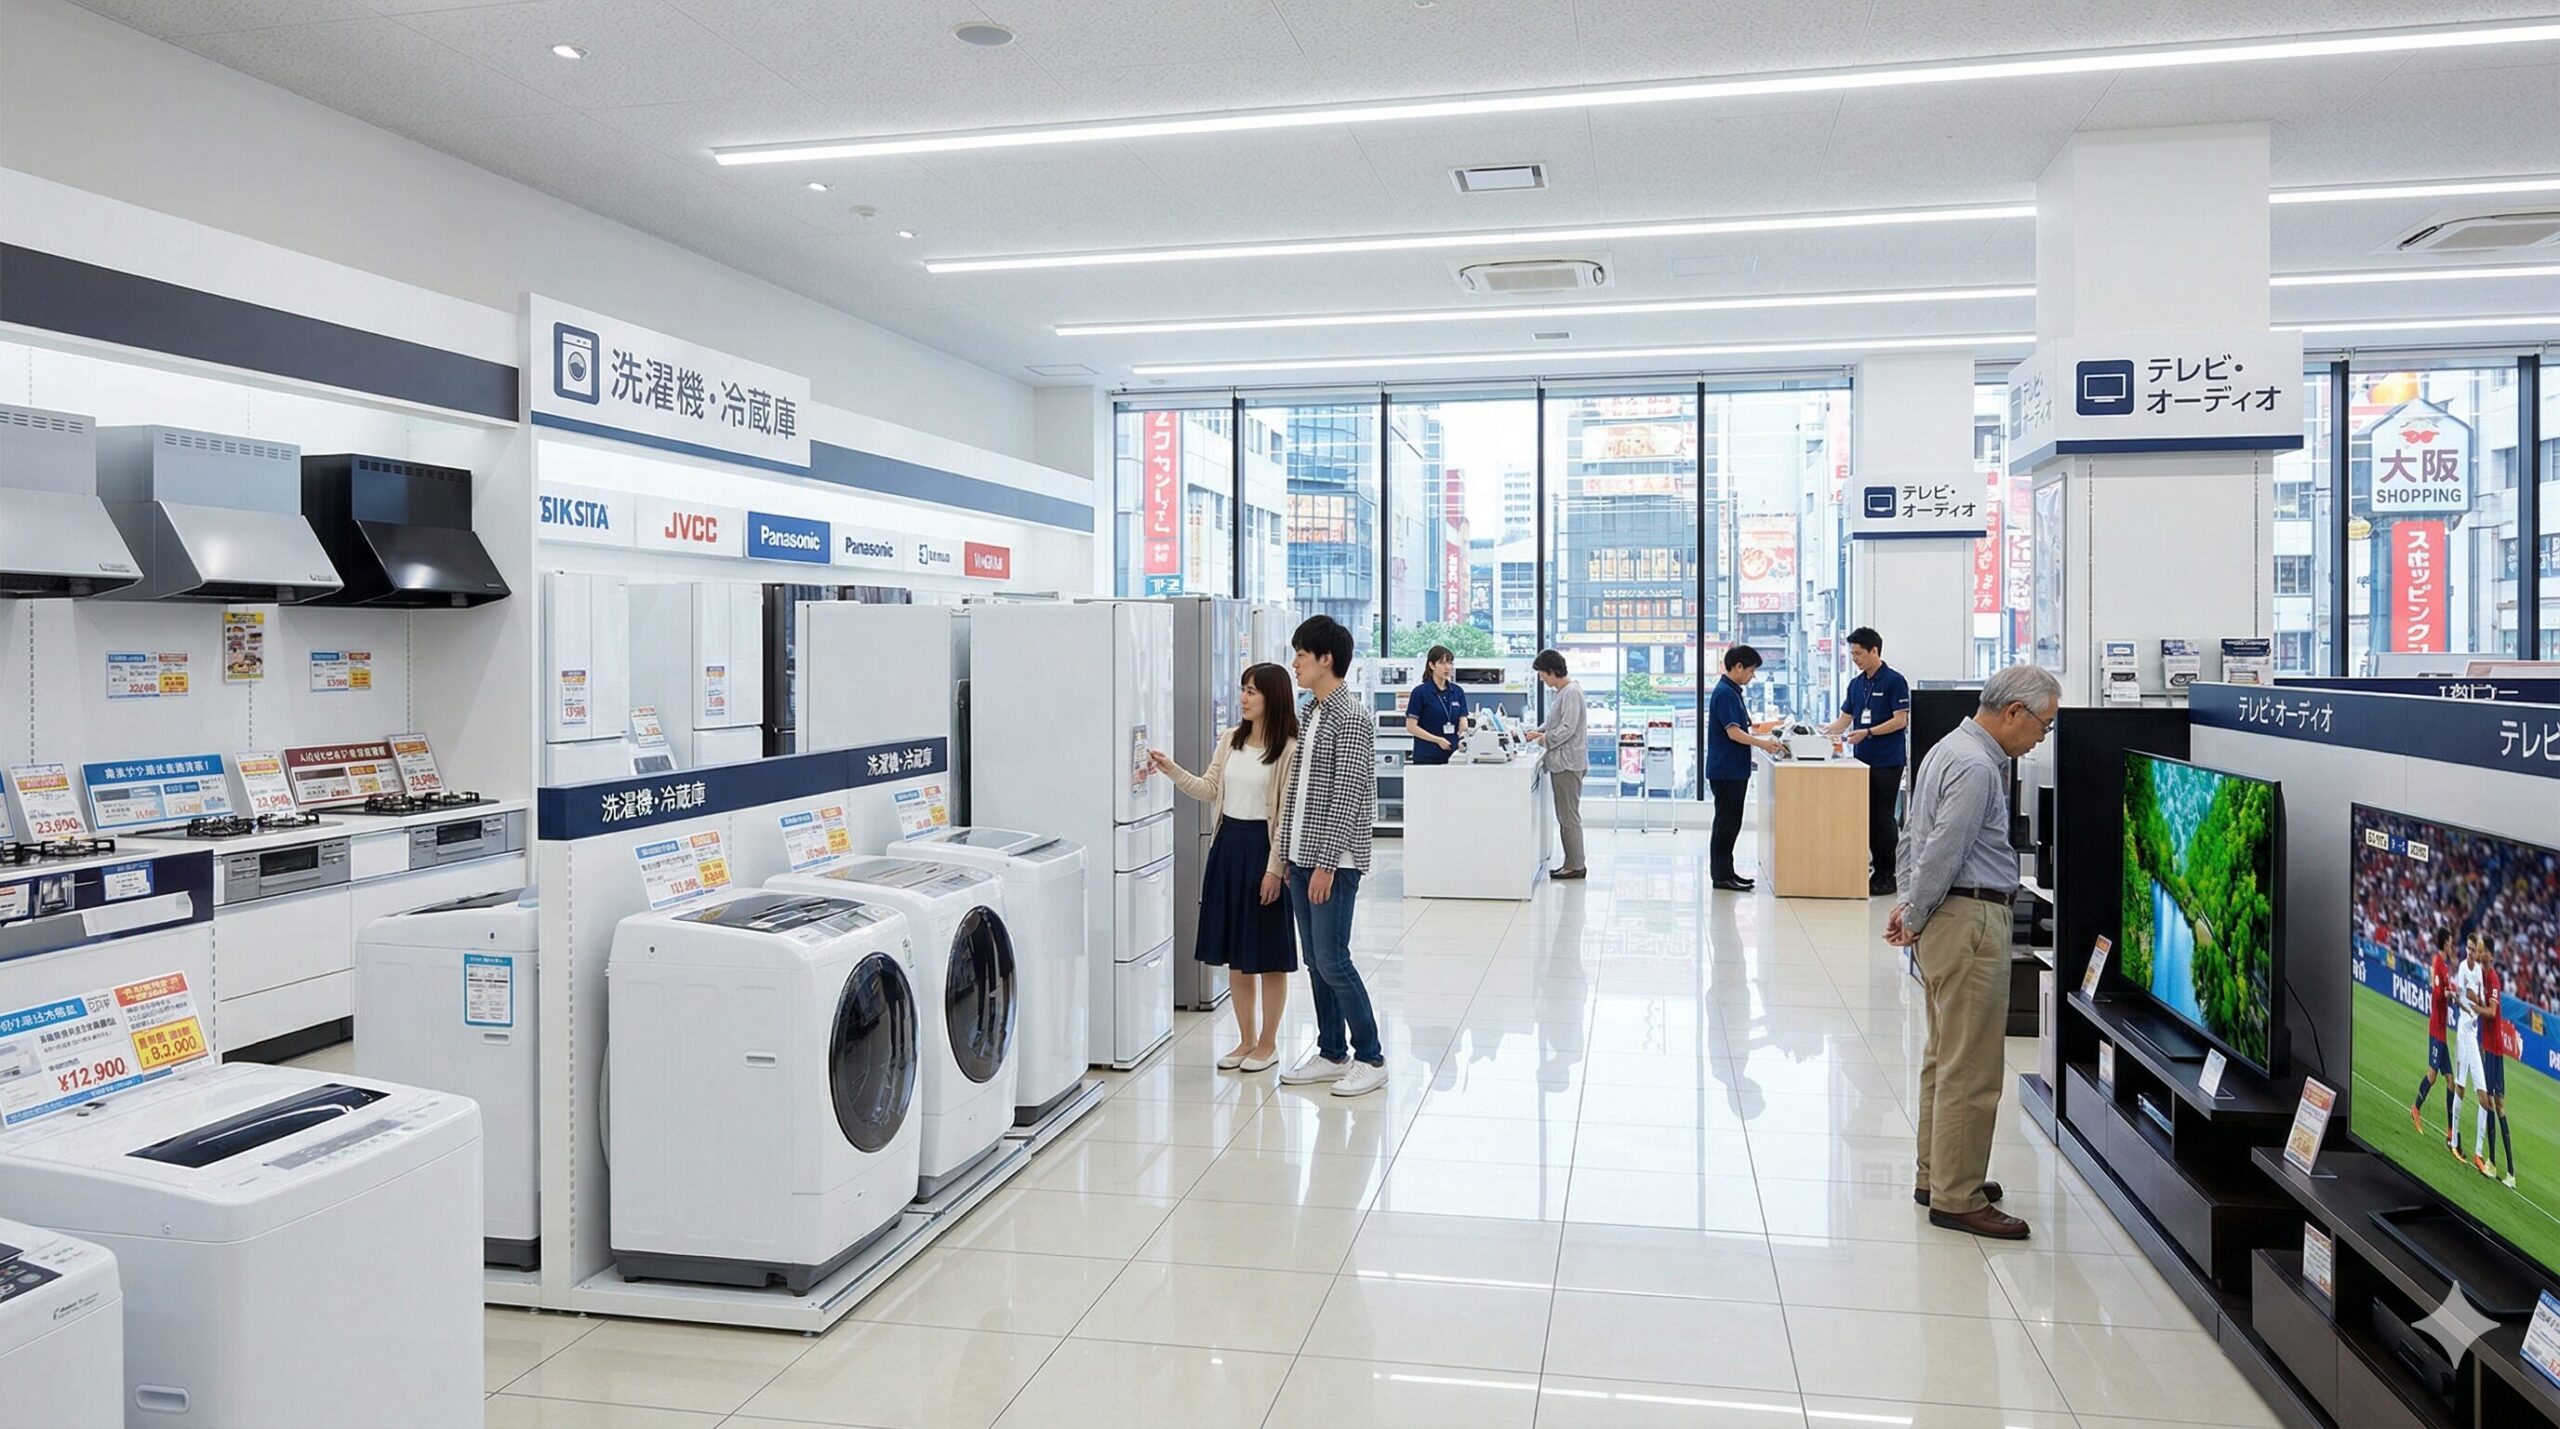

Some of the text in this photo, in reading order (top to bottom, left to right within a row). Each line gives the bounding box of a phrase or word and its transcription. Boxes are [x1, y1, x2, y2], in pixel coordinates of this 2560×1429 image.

[2147, 353, 2244, 383] テレビ・
[611, 348, 797, 440] 洗濯機・冷蔵庫
[2146, 385, 2282, 415] オーディオ
[2379, 449, 2460, 484] 大阪
[1902, 485, 1956, 501] テレビ・
[2376, 488, 2462, 504] SHOPPING
[1902, 503, 1976, 518] オーディオ
[664, 511, 718, 544] JVCC
[760, 525, 821, 551] Panasonic
[845, 536, 894, 559] Panasonic
[2238, 696, 2334, 734] テレビ・オーディオ
[601, 781, 706, 823] 洗濯機・冷蔵庫
[57, 1056, 126, 1092] ¥12,900
